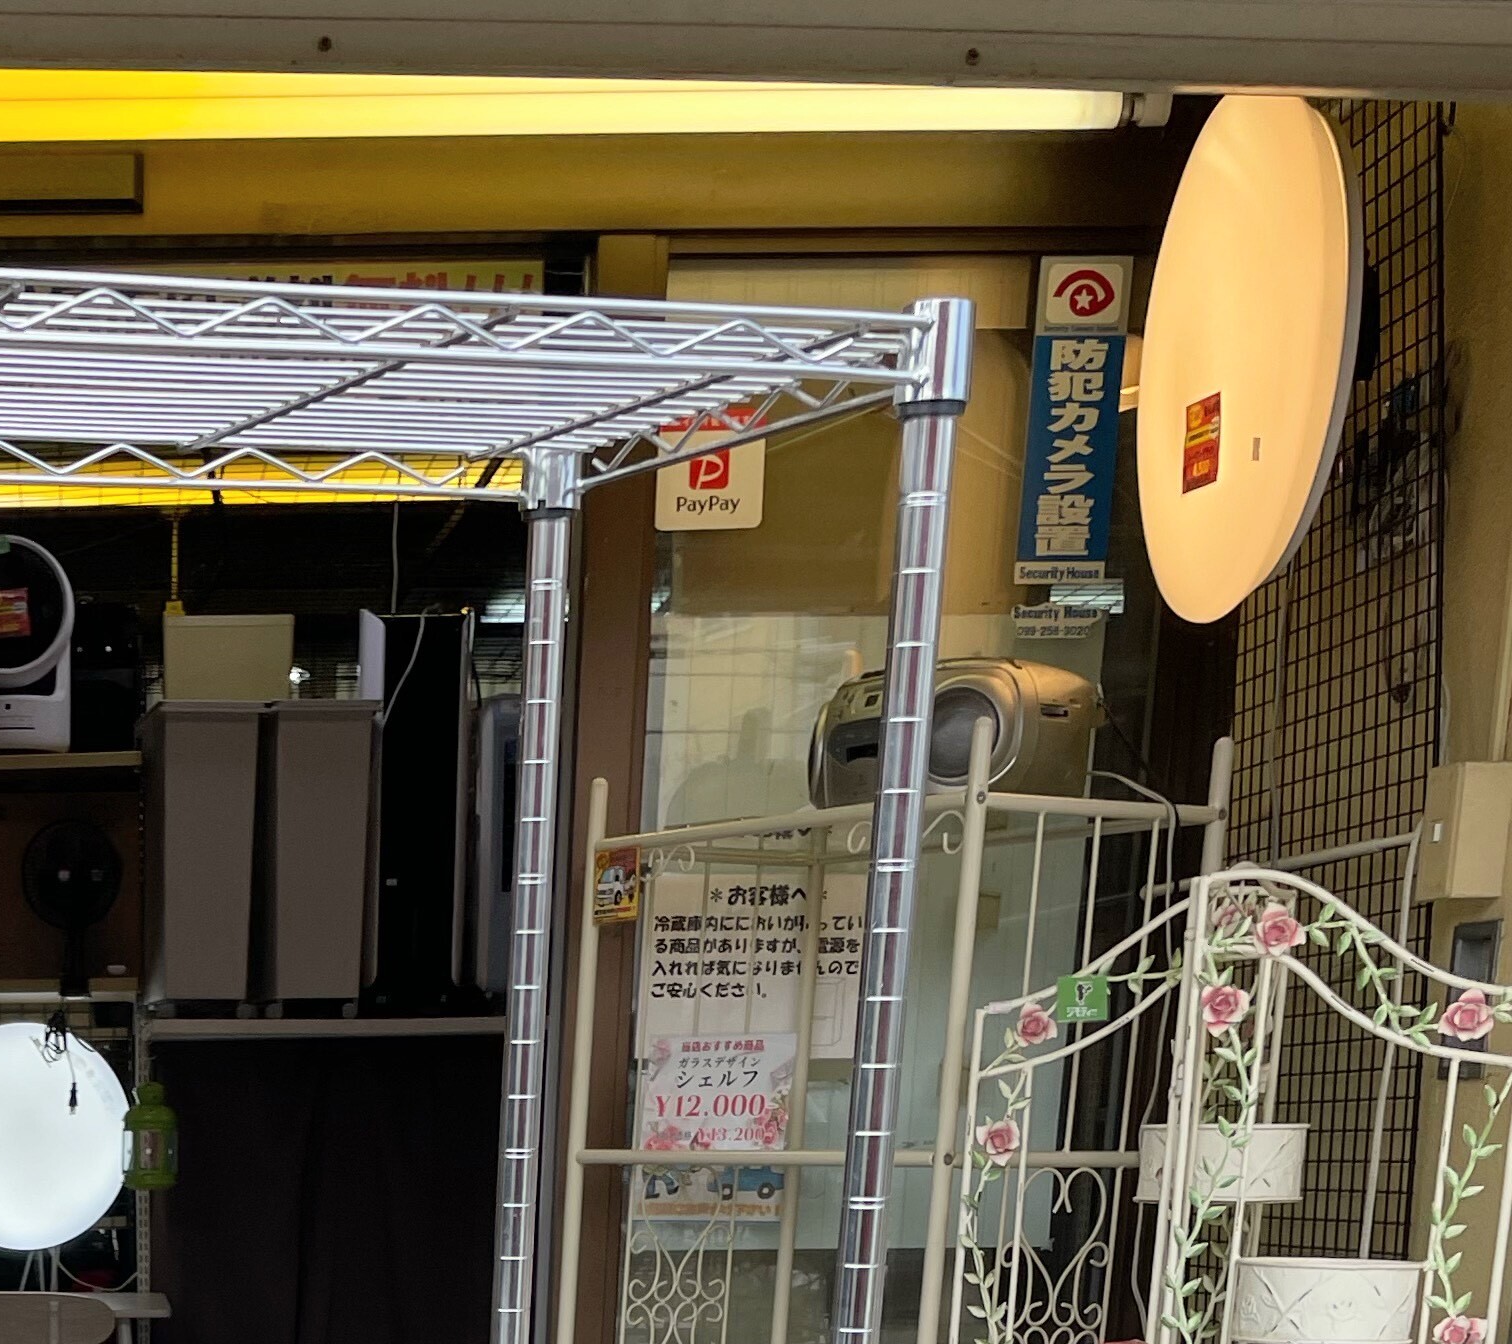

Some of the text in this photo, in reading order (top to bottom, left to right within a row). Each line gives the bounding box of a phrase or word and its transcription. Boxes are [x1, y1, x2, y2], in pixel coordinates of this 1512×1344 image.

[1035, 338, 1109, 557] 防犯カメラ設置
[676, 495, 741, 515] PayPay
[1019, 566, 1099, 582] Security House
[1014, 605, 1098, 622] Security House
[727, 884, 807, 907] お客様へ
[679, 1056, 761, 1069] ガラスデザイン
[676, 1070, 759, 1089] シェルフ
